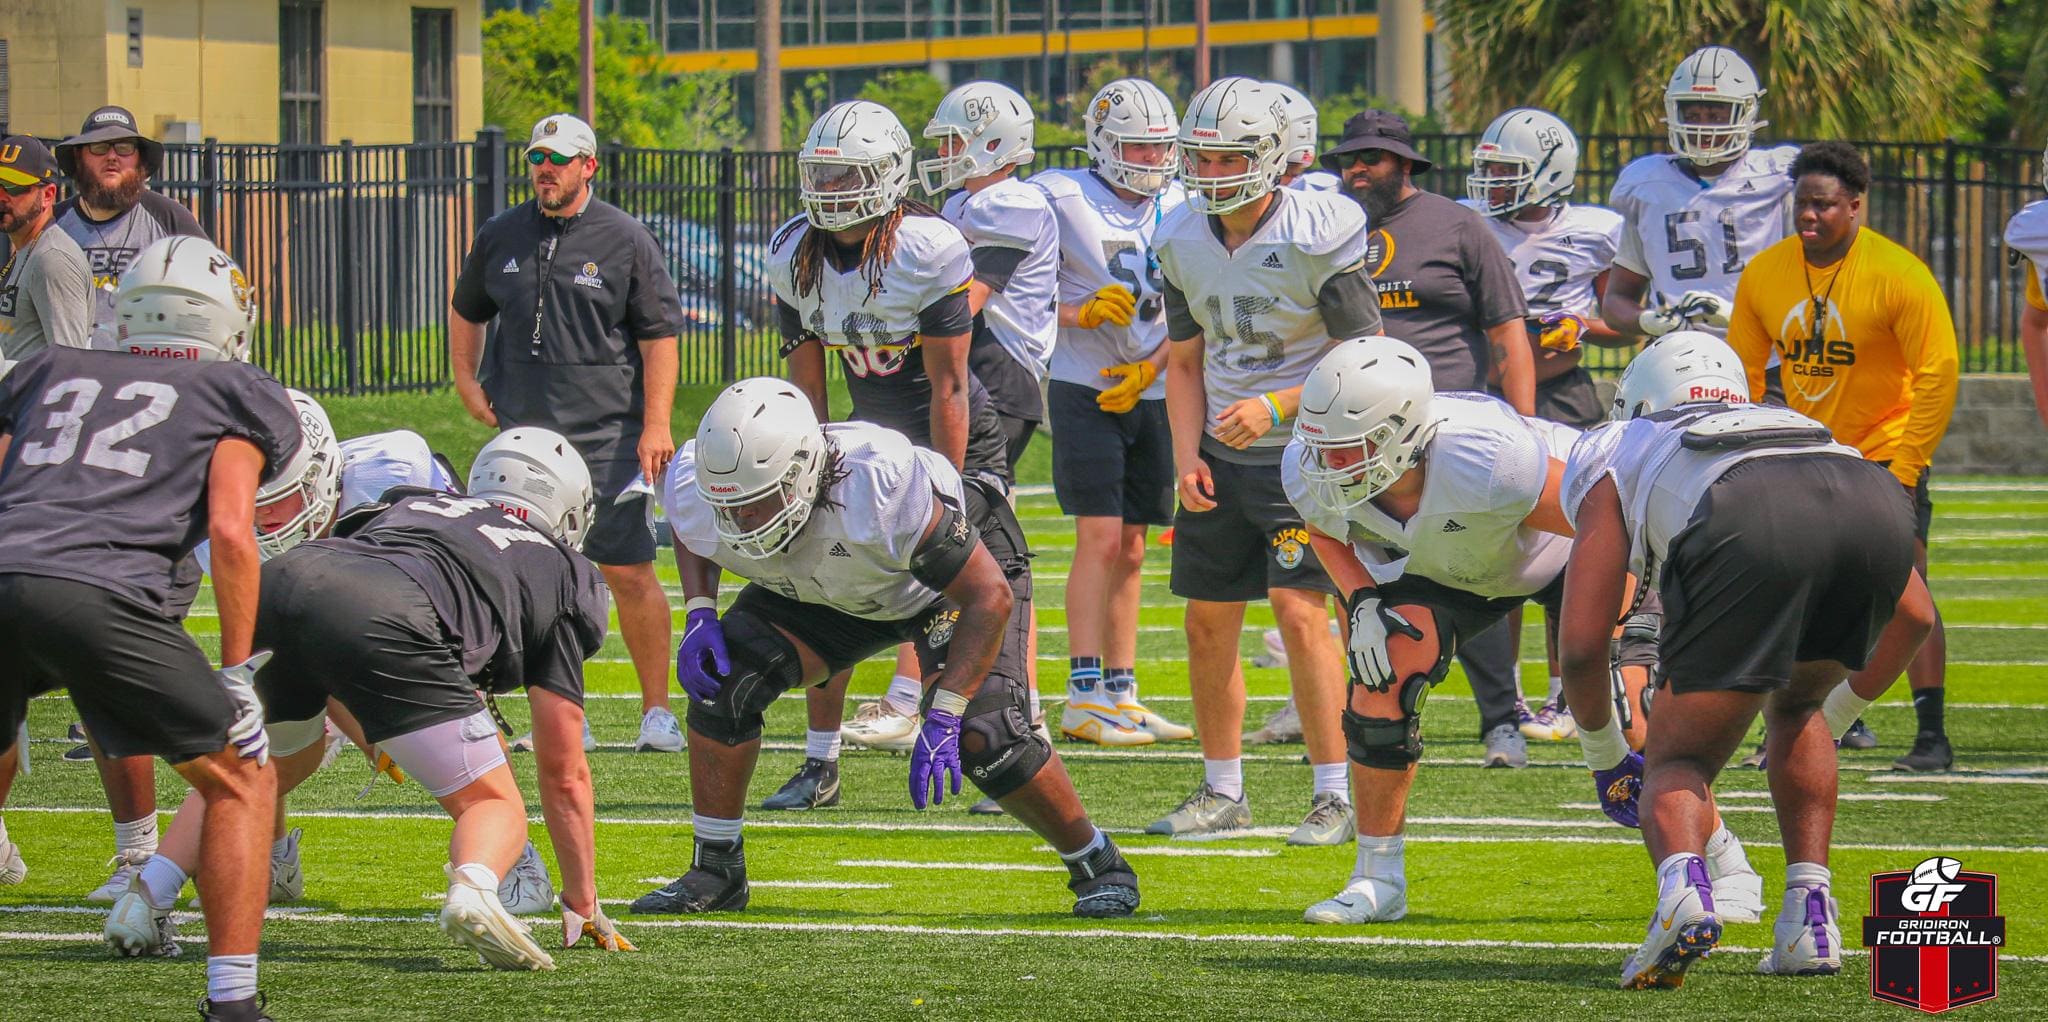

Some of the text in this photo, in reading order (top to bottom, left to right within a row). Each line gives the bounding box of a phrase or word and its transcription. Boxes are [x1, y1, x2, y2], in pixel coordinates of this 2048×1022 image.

[1193, 130, 1217, 138] Riddell
[1665, 208, 1745, 281] 51
[1205, 295, 1285, 371] 15
[21, 378, 179, 477] 32
